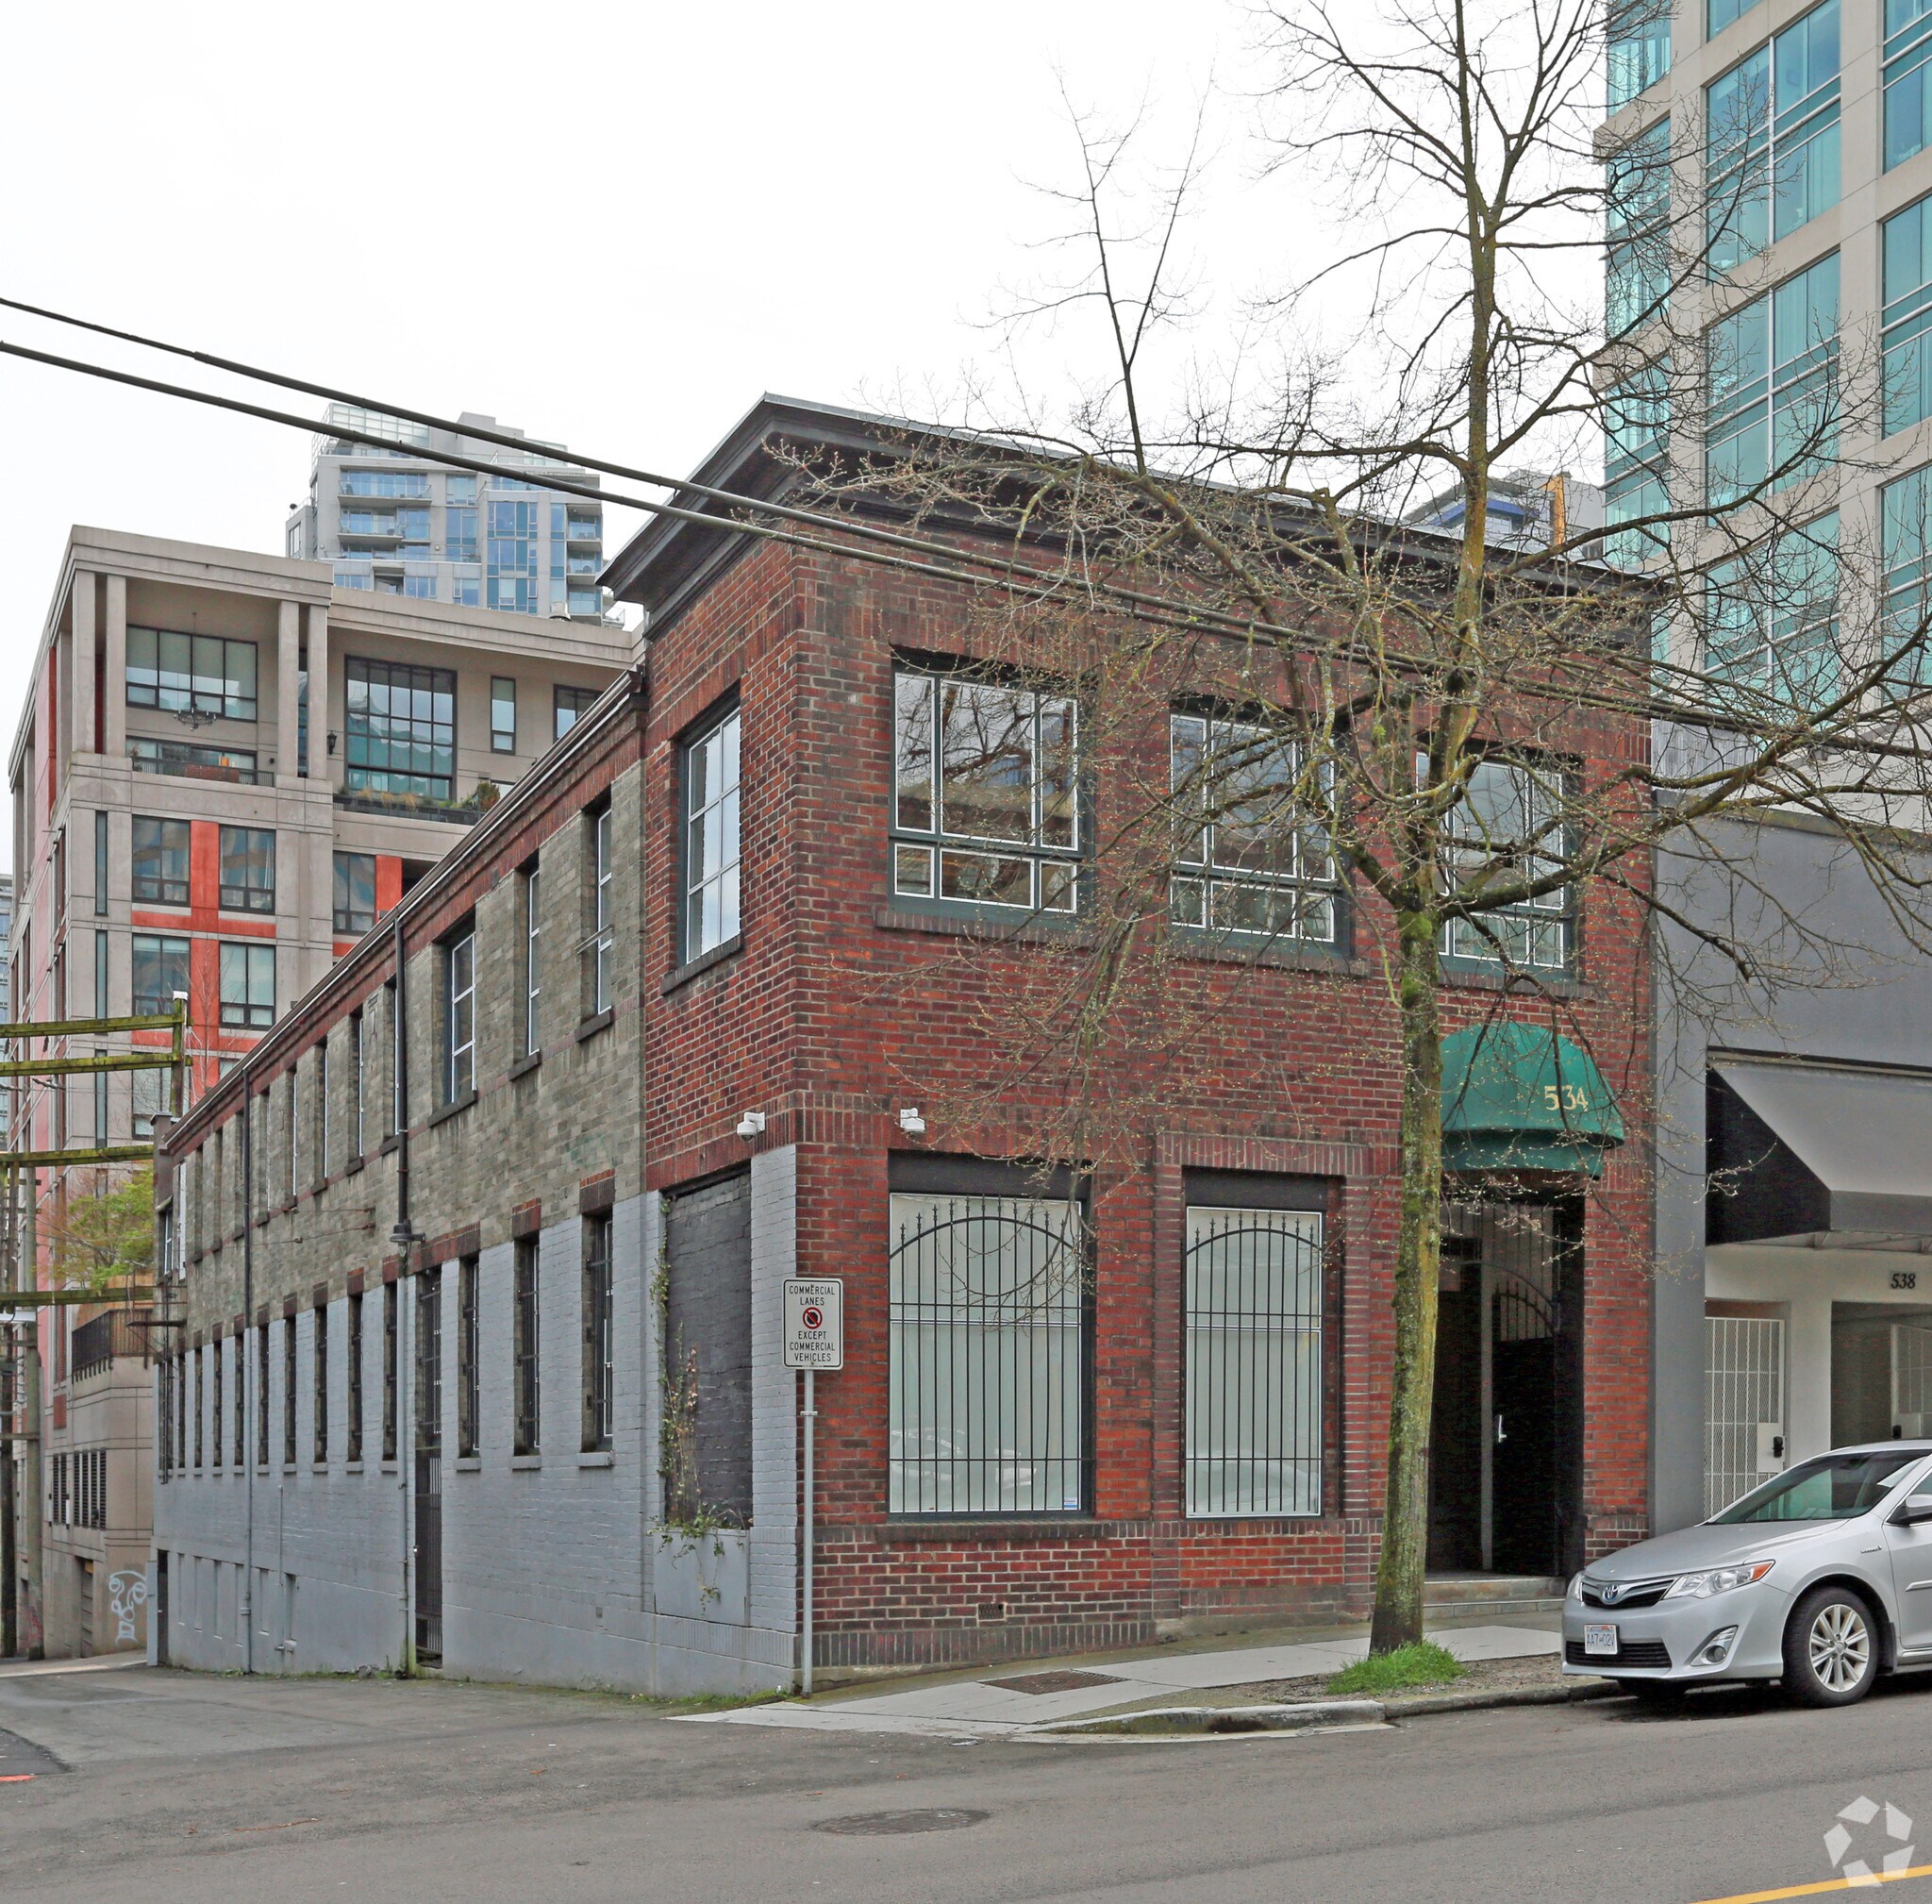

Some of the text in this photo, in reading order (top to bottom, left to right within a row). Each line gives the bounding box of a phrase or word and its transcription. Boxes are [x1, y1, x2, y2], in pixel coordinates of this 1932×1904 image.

[1544, 1085, 1589, 1111] 534
[1890, 1273, 1916, 1289] 538
[789, 1285, 835, 1294] COMMERCIAL
[800, 1297, 824, 1306] LANES
[798, 1330, 826, 1340] EXCEPT
[789, 1342, 835, 1351] COMMERCIAL
[794, 1353, 831, 1361] VEHICLES
